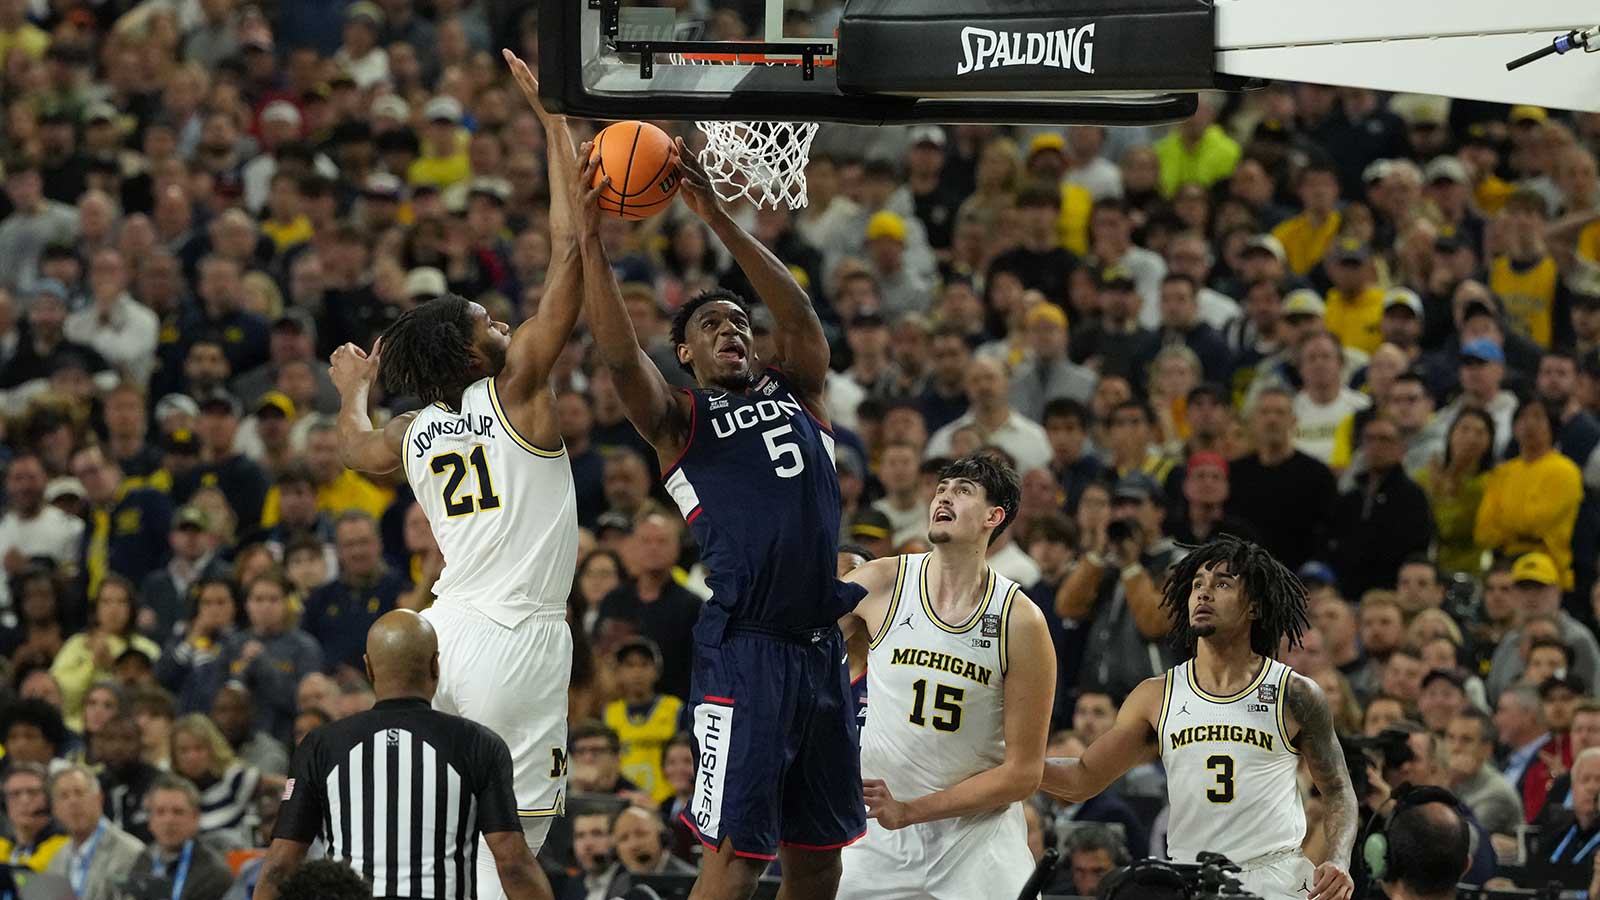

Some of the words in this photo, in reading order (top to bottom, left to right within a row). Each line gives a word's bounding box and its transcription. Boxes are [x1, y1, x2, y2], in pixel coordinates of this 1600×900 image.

[957, 23, 1095, 75] SPALDING
[474, 414, 496, 439] JR.
[762, 424, 805, 477] 5
[429, 443, 500, 518] 21
[891, 648, 993, 685] MICHIGAN
[908, 678, 965, 732] 15
[1170, 725, 1274, 751] MICHIGAN
[697, 713, 721, 829] HUSKIES
[1206, 754, 1236, 804] 3
